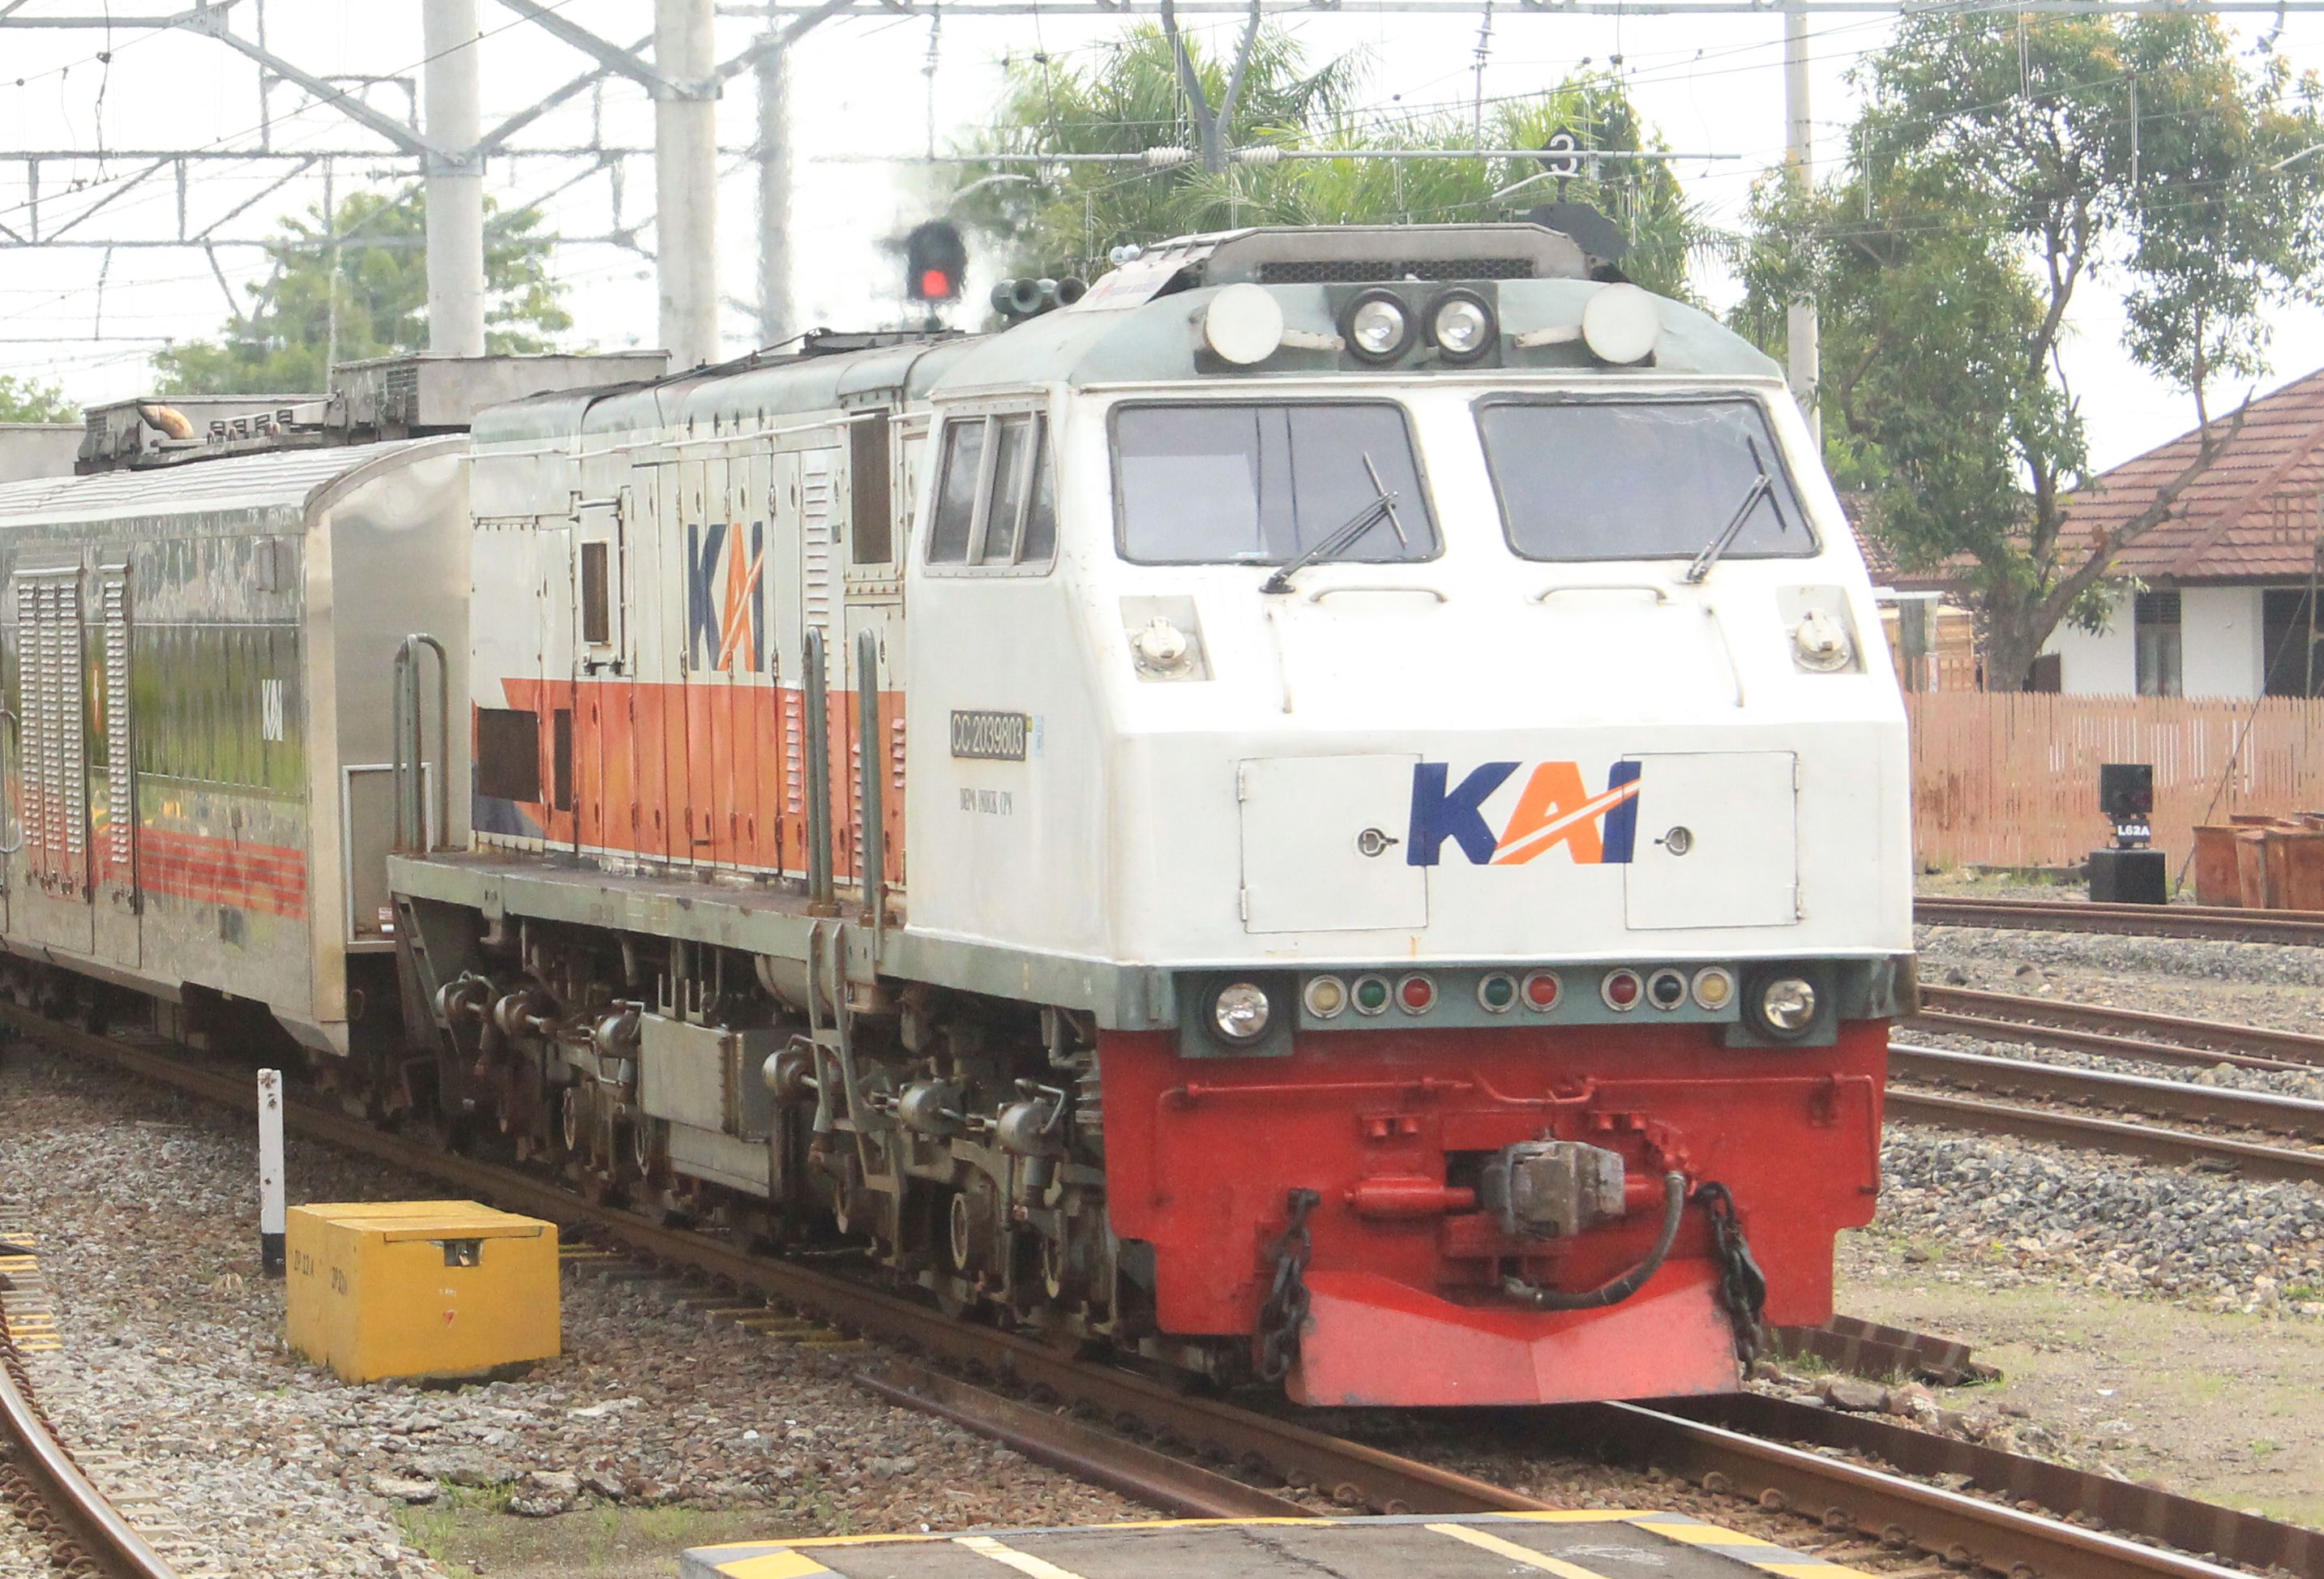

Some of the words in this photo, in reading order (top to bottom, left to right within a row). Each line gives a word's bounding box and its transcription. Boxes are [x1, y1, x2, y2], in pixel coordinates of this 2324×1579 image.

[1550, 134, 1577, 173] 3
[688, 520, 764, 673] KAI
[952, 713, 970, 752] CC
[973, 715, 1023, 755] 2039803
[1407, 761, 1642, 866] KAI
[2117, 824, 2151, 837] L62A
